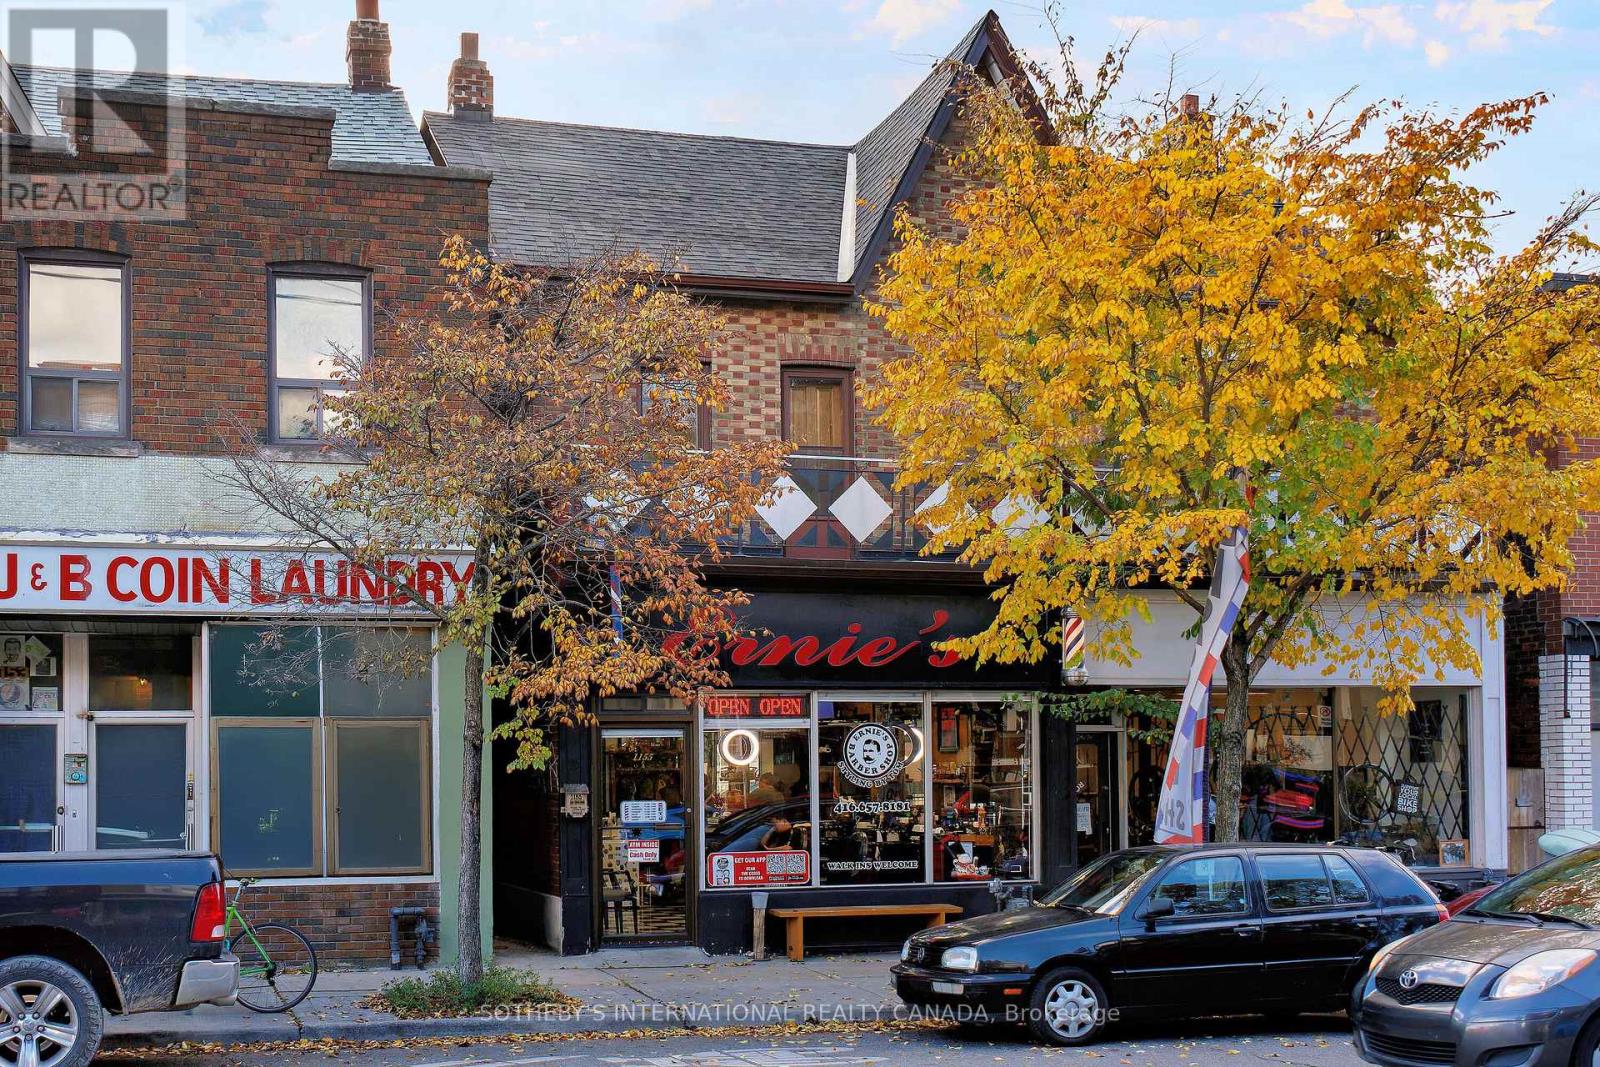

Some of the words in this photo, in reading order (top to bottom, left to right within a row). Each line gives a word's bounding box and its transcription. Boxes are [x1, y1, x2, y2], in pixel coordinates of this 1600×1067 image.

[0, 553, 18, 600] J
[30, 563, 48, 591] &
[60, 554, 92, 601] B
[106, 556, 230, 604] COIN
[250, 558, 476, 607] LAUNDRY
[707, 698, 750, 715] OPEN
[759, 698, 801, 715] OPEN
[853, 727, 890, 742] ERNIE'S
[848, 743, 878, 775] BARBER
[879, 743, 894, 771] SHOP
[837, 760, 873, 789] STYLING
[834, 800, 910, 814] 416.657.8181
[1397, 798, 1418, 808] BIKE
[1397, 805, 1418, 813] SHOP
[827, 861, 854, 871] WALK
[855, 861, 872, 870] INS
[873, 860, 919, 871] WELCOME
